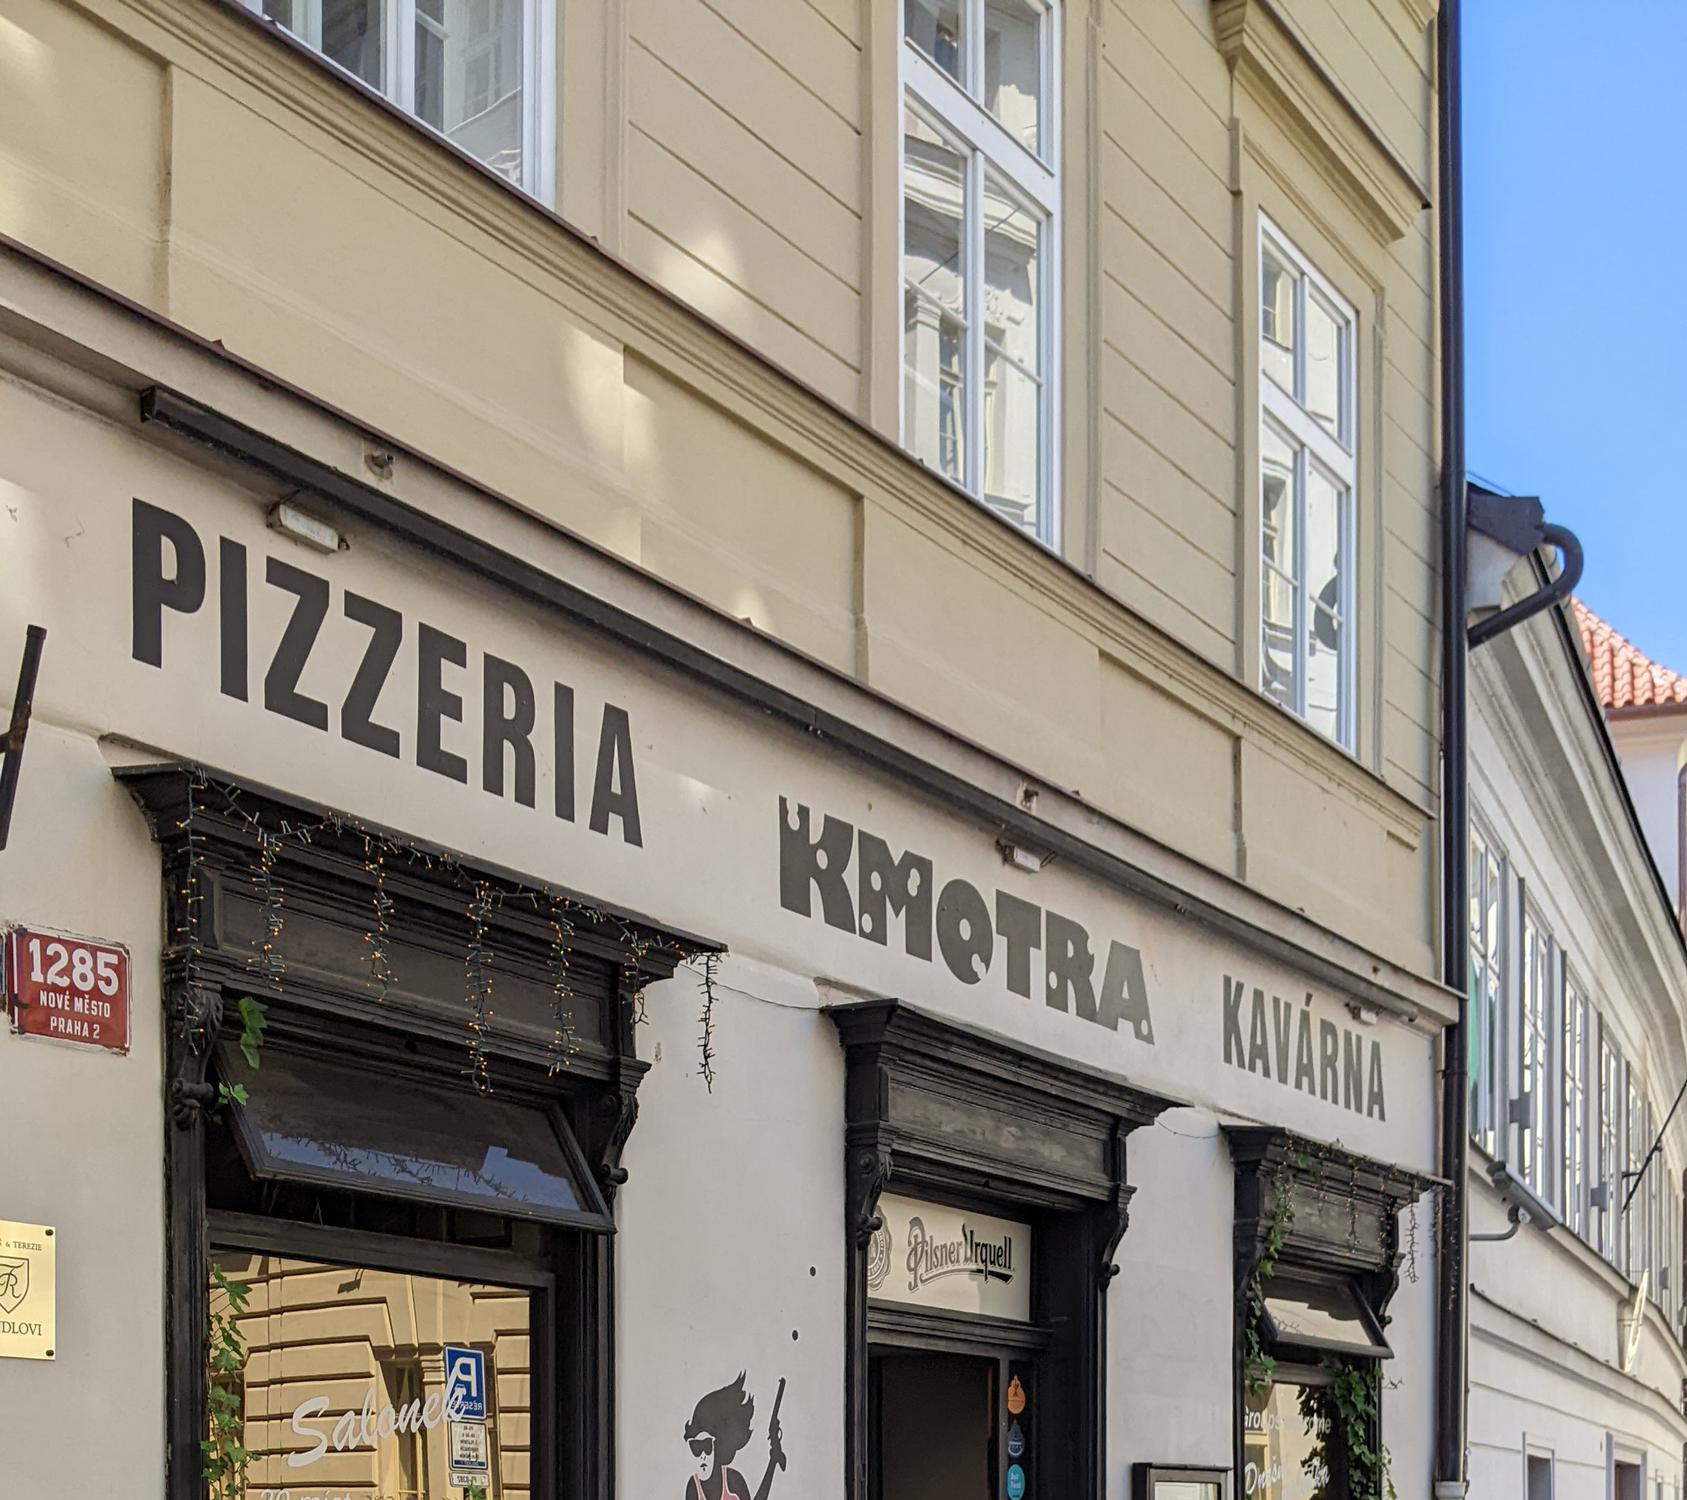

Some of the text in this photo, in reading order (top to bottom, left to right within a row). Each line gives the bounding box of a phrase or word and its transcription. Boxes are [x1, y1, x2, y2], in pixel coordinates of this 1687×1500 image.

[132, 497, 1385, 1122] PIZZERIA KMOTRA KAVÁRNA
[29, 938, 119, 996] 1285
[40, 989, 111, 1018] NOVÉ MĚSTO
[50, 1016, 100, 1039] PRAHA 2
[13, 1240, 42, 1252] TEREZIE
[906, 1216, 964, 1293] Pilsner
[962, 1223, 1012, 1283] Urquell
[0, 1320, 42, 1337] DLOVI
[287, 1364, 467, 1468] Salonek
